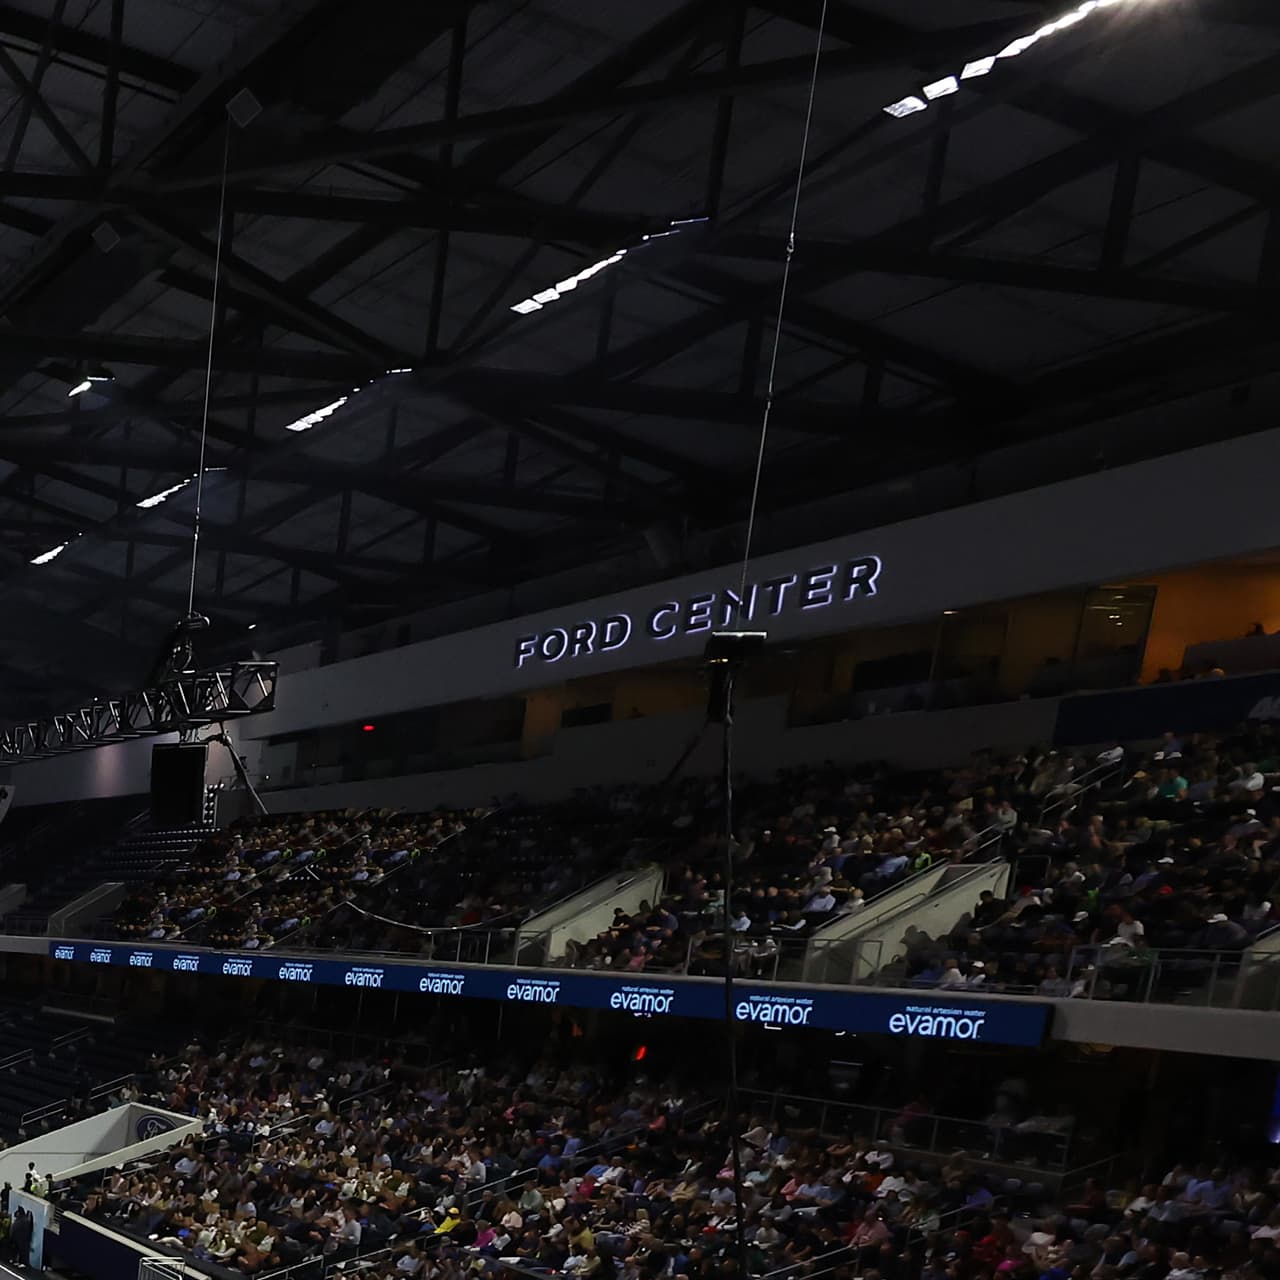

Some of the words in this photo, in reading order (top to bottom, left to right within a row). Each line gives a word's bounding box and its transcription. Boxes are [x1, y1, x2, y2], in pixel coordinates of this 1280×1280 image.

[516, 613, 632, 668] FORD
[647, 555, 882, 640] CENTER
[54, 949, 75, 960] evamor
[90, 951, 111, 963] evamor
[129, 955, 153, 967] evamor
[173, 958, 200, 971] evamor
[223, 962, 252, 976] evamor
[279, 966, 313, 982] evamor
[345, 970, 383, 988] evamor
[419, 977, 465, 994] evamor
[507, 983, 560, 1002] evamor
[610, 992, 674, 1013] evamor
[736, 1002, 813, 1024] evamor
[889, 1013, 985, 1039] evamor
